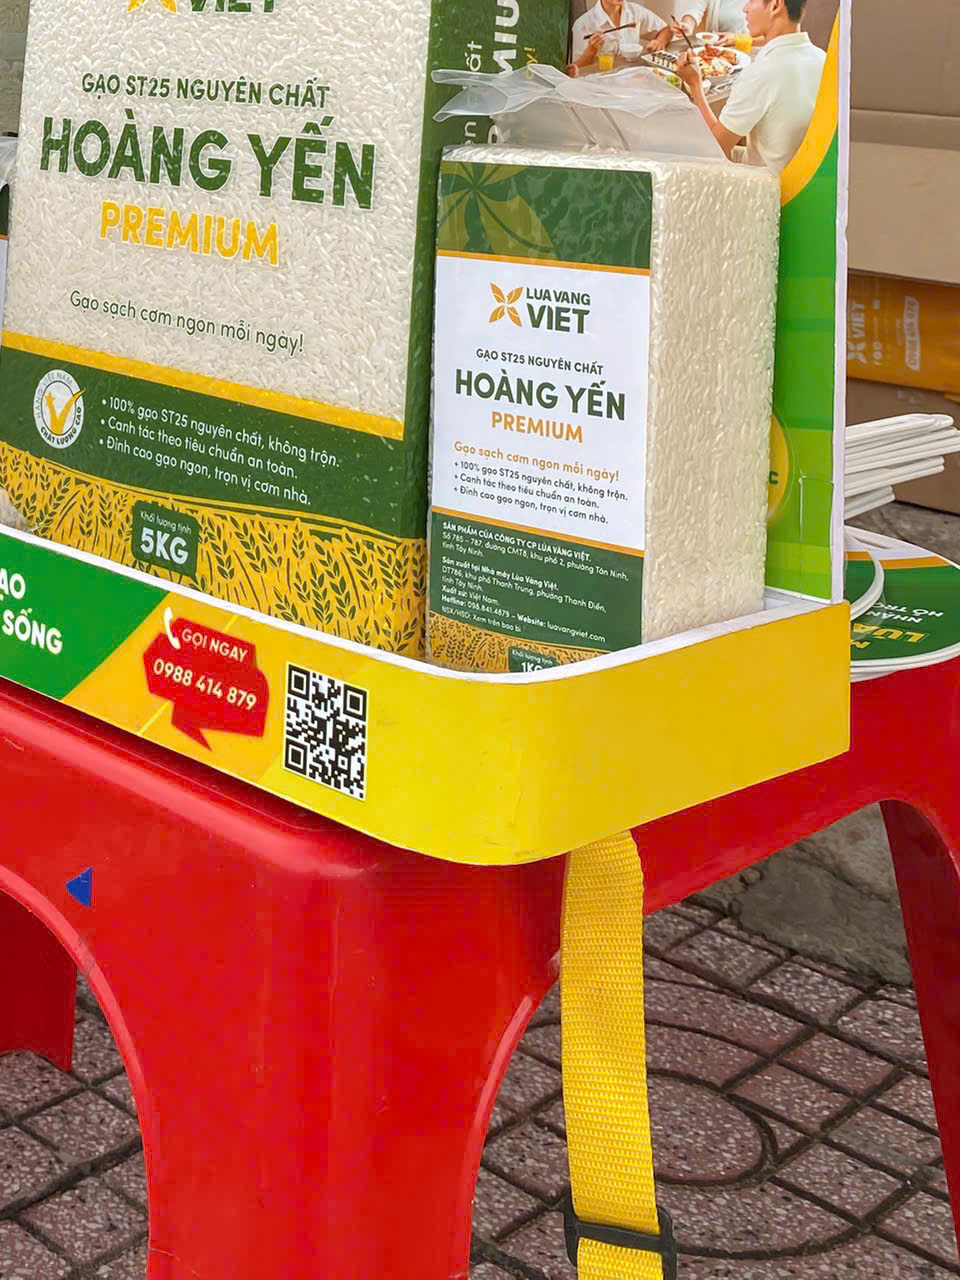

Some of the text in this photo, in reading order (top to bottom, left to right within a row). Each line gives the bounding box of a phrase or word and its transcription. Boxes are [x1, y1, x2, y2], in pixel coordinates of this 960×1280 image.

[81, 73, 330, 108] GẠO ST25 NGUYÊN CHẤT
[40, 108, 375, 210] HOÀNG YẾN
[100, 202, 279, 266] PREMIUM
[70, 290, 98, 312] Gạo
[103, 300, 136, 319] sạch
[140, 307, 171, 325] cơm
[176, 315, 215, 335] ngon
[255, 330, 303, 356] ngày!
[526, 303, 590, 334] VIET
[501, 352, 603, 375] ST25 NGUYÊN CHẤT
[455, 368, 625, 421] HOÀNG YẾN
[108, 416, 298, 479] Canh tác theo tiêu chuẩn an toàn.
[110, 397, 340, 468] 100% gạo ST25 nguyên chất, không trộn.
[491, 411, 583, 443] PREMIUM
[133, 446, 153, 460] cao
[155, 452, 177, 468] gạo
[179, 458, 211, 479] ngon,
[214, 466, 238, 486] trọn
[240, 475, 251, 493] vị
[254, 479, 280, 497] cơm
[284, 487, 311, 505] nhà.
[532, 457, 560, 471] ngon
[140, 527, 189, 565] 5KG
[1, 607, 63, 655] SỐNG
[182, 628, 248, 663] GỌI NGAY
[153, 658, 257, 710] 0988 414 879
